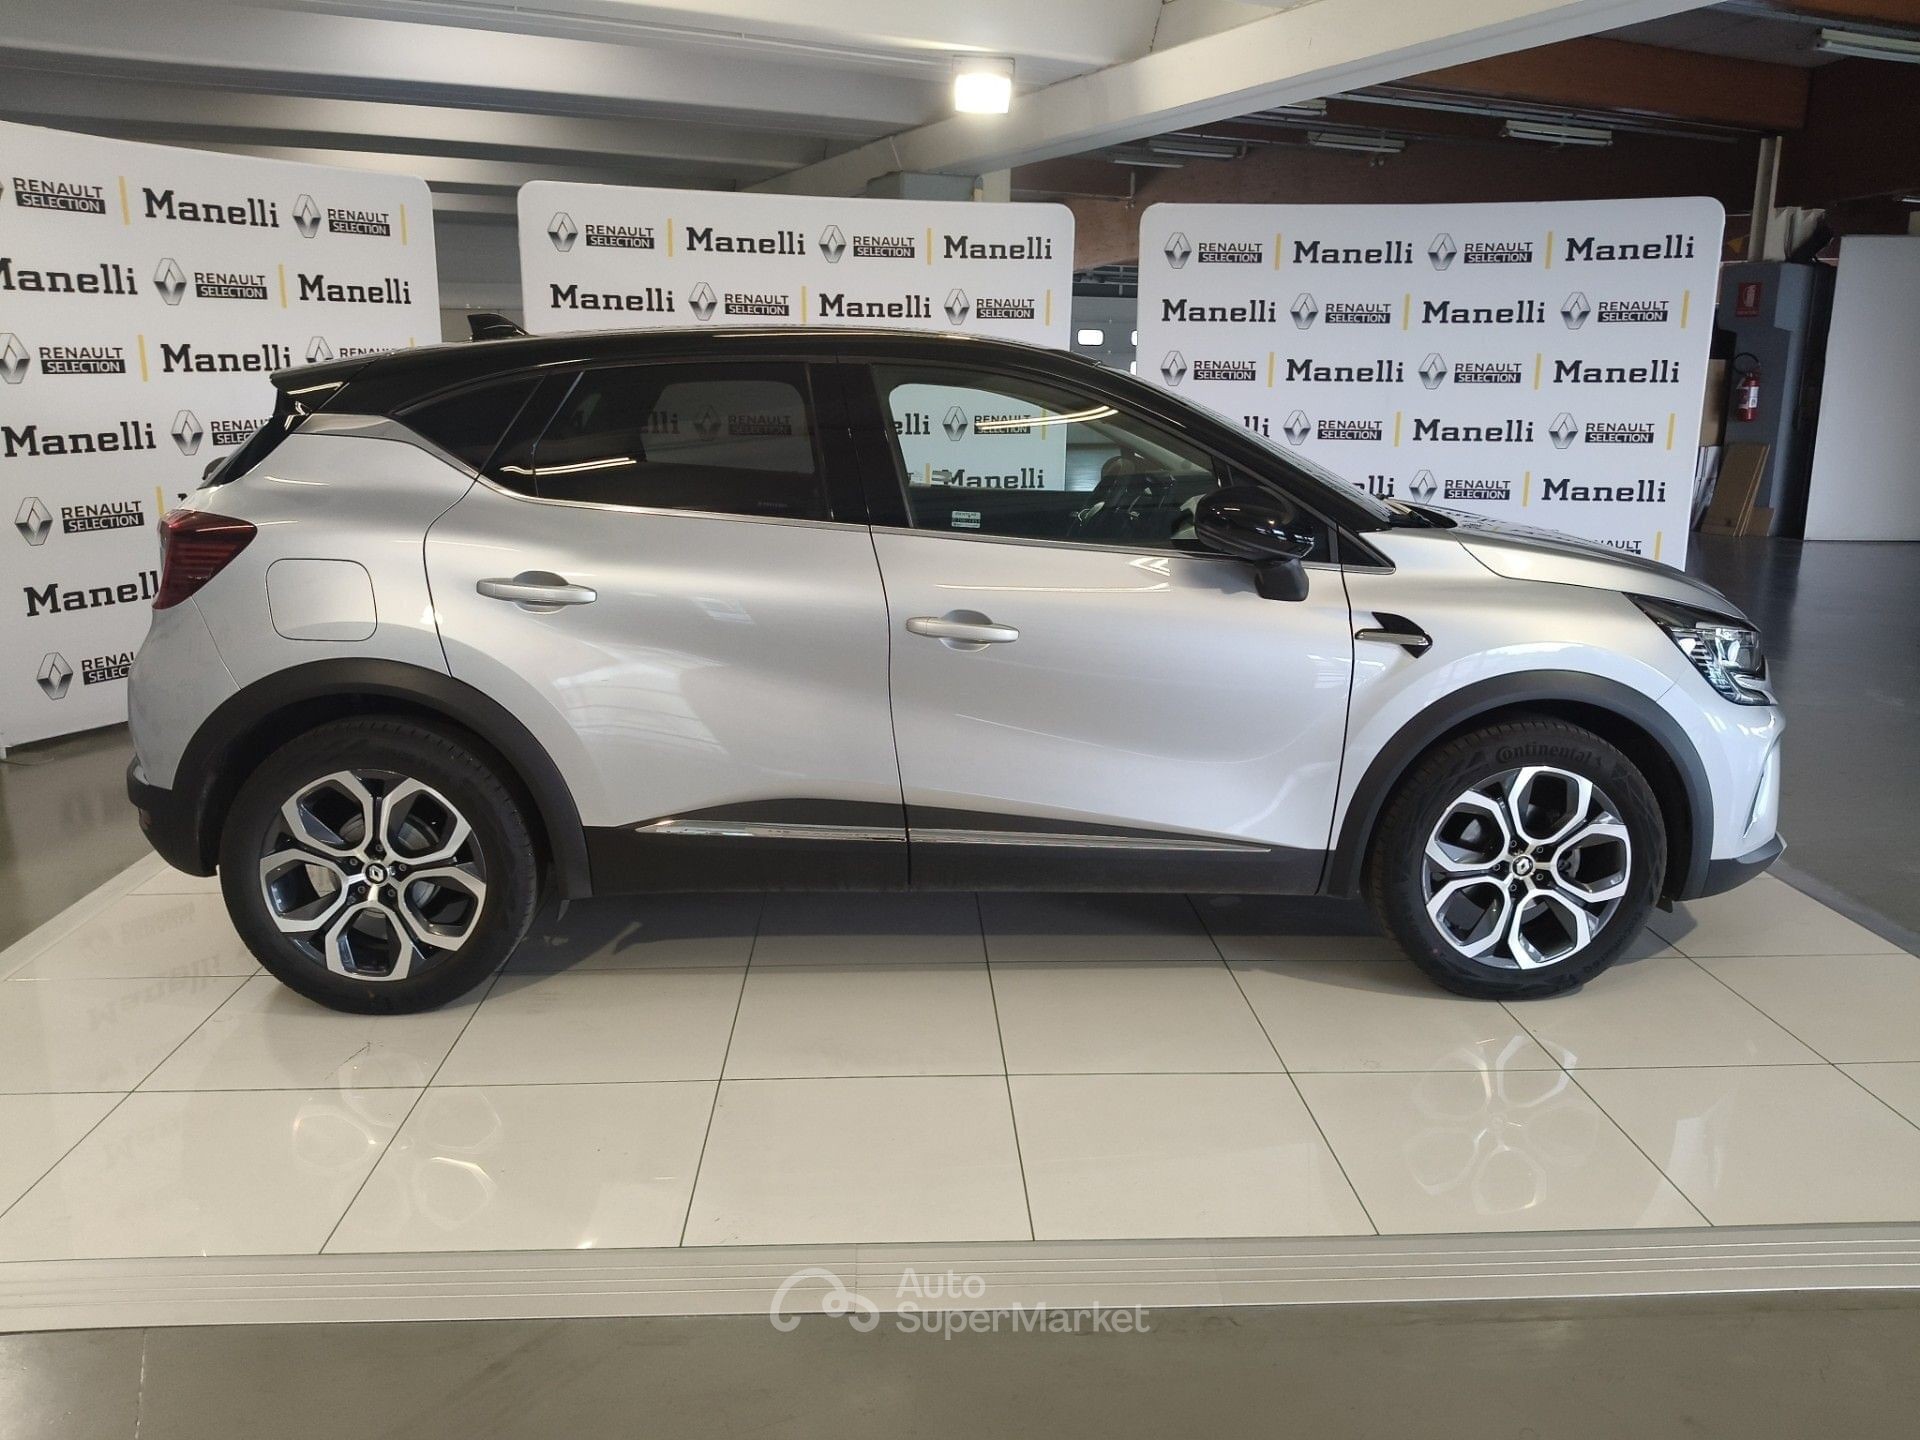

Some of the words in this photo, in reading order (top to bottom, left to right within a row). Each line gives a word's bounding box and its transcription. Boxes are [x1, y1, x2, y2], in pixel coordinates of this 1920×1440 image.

[13, 178, 103, 198] RENAULT
[20, 192, 100, 213] SELECTION
[143, 188, 279, 228] Manelli
[328, 209, 389, 223] RENAULT
[333, 220, 387, 235] SELECTION
[586, 225, 654, 238] RENAULT
[590, 239, 651, 248] SELECTION
[686, 227, 805, 255] Manelli
[853, 236, 914, 247] RENAULT
[944, 235, 1052, 259] Manelli
[1465, 242, 1533, 253] RENAULT
[857, 248, 911, 257] SELECTION
[1199, 243, 1262, 253] RENAULT
[1293, 241, 1412, 264] Manelli
[1565, 236, 1694, 261] Manelli
[1202, 253, 1259, 262] SELECTION
[1468, 252, 1529, 262] SELECTION
[194, 272, 265, 286] RENAULT
[200, 285, 263, 298] SELECTION
[298, 274, 411, 304] Manelli
[550, 284, 675, 312] Manelli
[725, 294, 789, 305] RENAULT
[977, 299, 1034, 308] RENAULT
[729, 306, 786, 315] SELECTION
[819, 294, 931, 318] Manelli
[1162, 299, 1276, 323] Manelli
[1326, 304, 1391, 313] RENAULT
[1422, 300, 1545, 324] Manelli
[1599, 301, 1669, 311] RENAULT
[980, 309, 1031, 318] SELECTION
[1329, 313, 1387, 322] SELECTION
[1602, 311, 1664, 321] SELECTION
[39, 347, 123, 360] RENAULT
[160, 344, 293, 373] Manelli
[46, 360, 121, 373] SELECTION
[1194, 361, 1256, 371] RENAULT
[1286, 359, 1403, 383] Manelli
[1455, 363, 1522, 373] RENAULT
[1553, 360, 1679, 383] Manelli
[1198, 370, 1253, 380] SELECTION
[1458, 373, 1518, 382] SELECTION
[1318, 420, 1382, 430] RENAULT
[1413, 419, 1533, 442] Manelli
[1586, 423, 1654, 433] RENAULT
[1, 421, 156, 457] Manelli
[217, 432, 251, 444] SELEC
[1322, 431, 1379, 439] SELECTION
[1589, 433, 1651, 442] SELECTION
[1445, 480, 1511, 490] RENAULT
[1542, 479, 1665, 502] Manelli
[1448, 491, 1507, 499] SELECTION
[62, 501, 142, 517] RENAULT
[68, 513, 140, 532] SELECTION
[24, 571, 159, 616] Manell
[89, 667, 129, 682] SELEC
[1496, 741, 1592, 763] Continental
